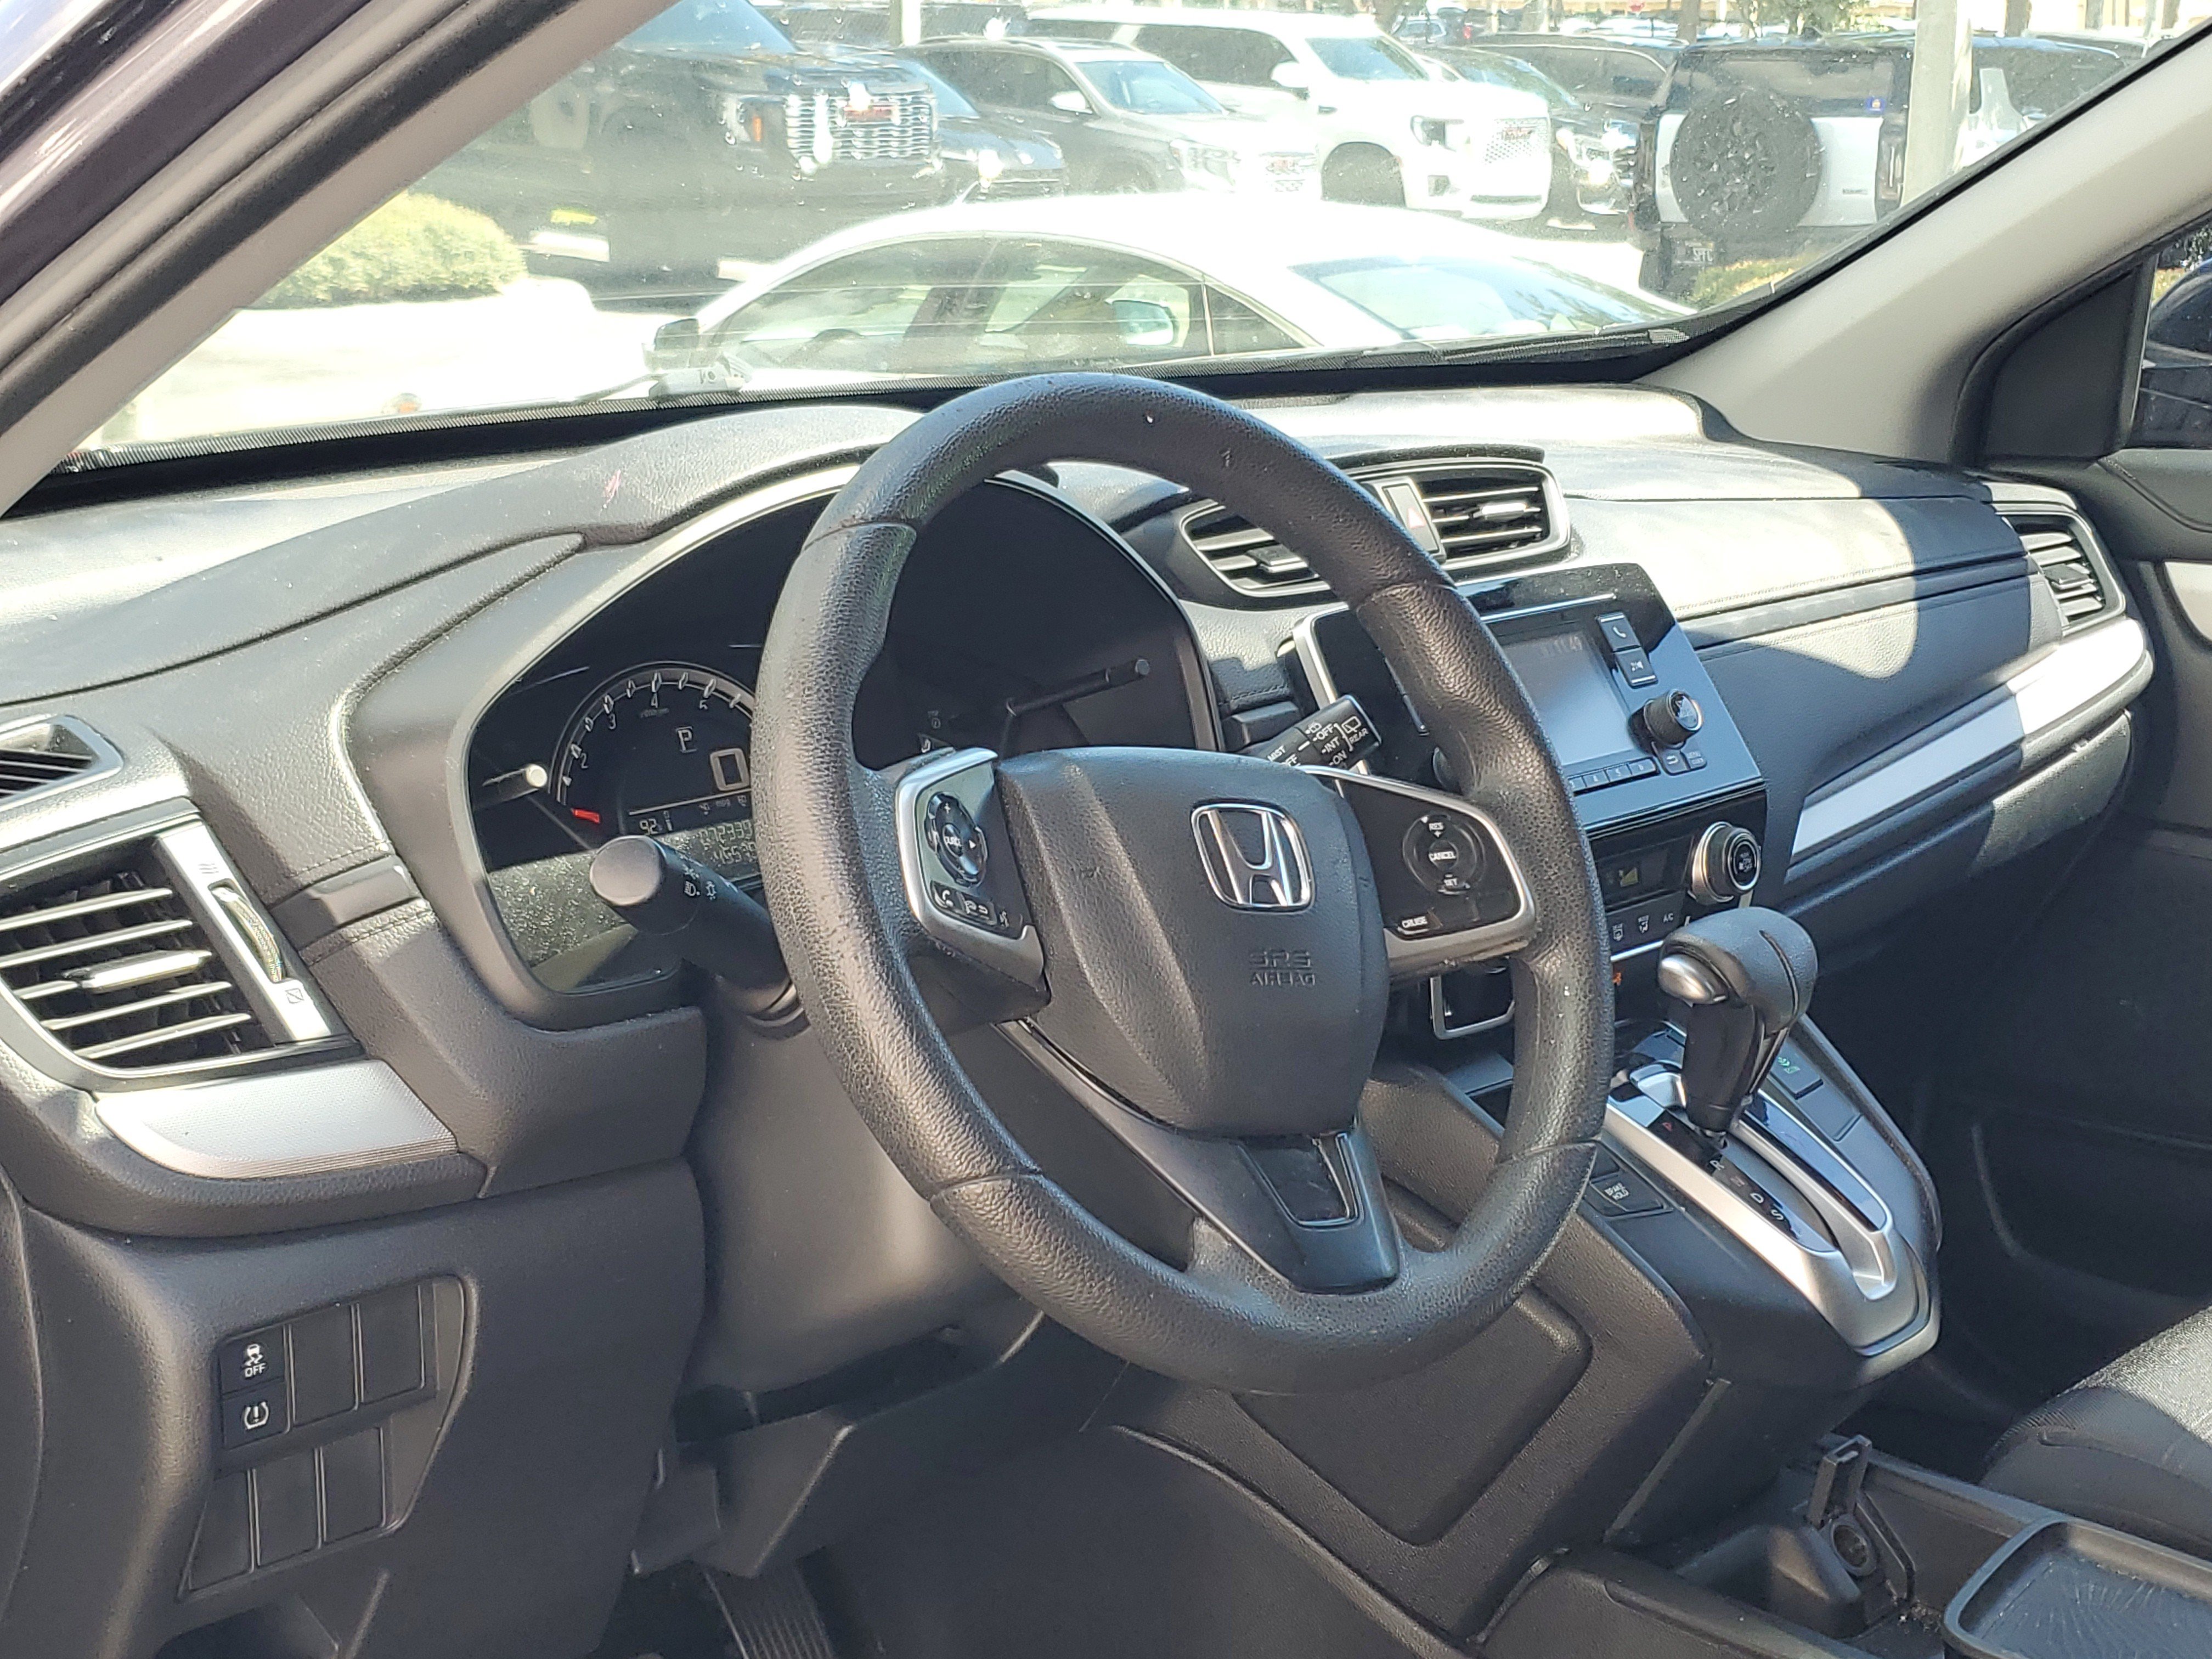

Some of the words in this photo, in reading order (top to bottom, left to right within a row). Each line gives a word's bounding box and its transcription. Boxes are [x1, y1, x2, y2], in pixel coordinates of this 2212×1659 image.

[1316, 723, 1334, 740] OFF
[1350, 727, 1370, 745] REAR
[1324, 736, 1340, 753] INT
[1331, 750, 1347, 765] ON
[1428, 851, 1457, 860] CANCEL
[1401, 916, 1428, 928] CRUISE
[1249, 948, 1313, 970] SRS
[1709, 1160, 1725, 1170] R
[1750, 1192, 1764, 1204] D
[1770, 1209, 1784, 1221] S
[245, 1363, 267, 1378] OFF
